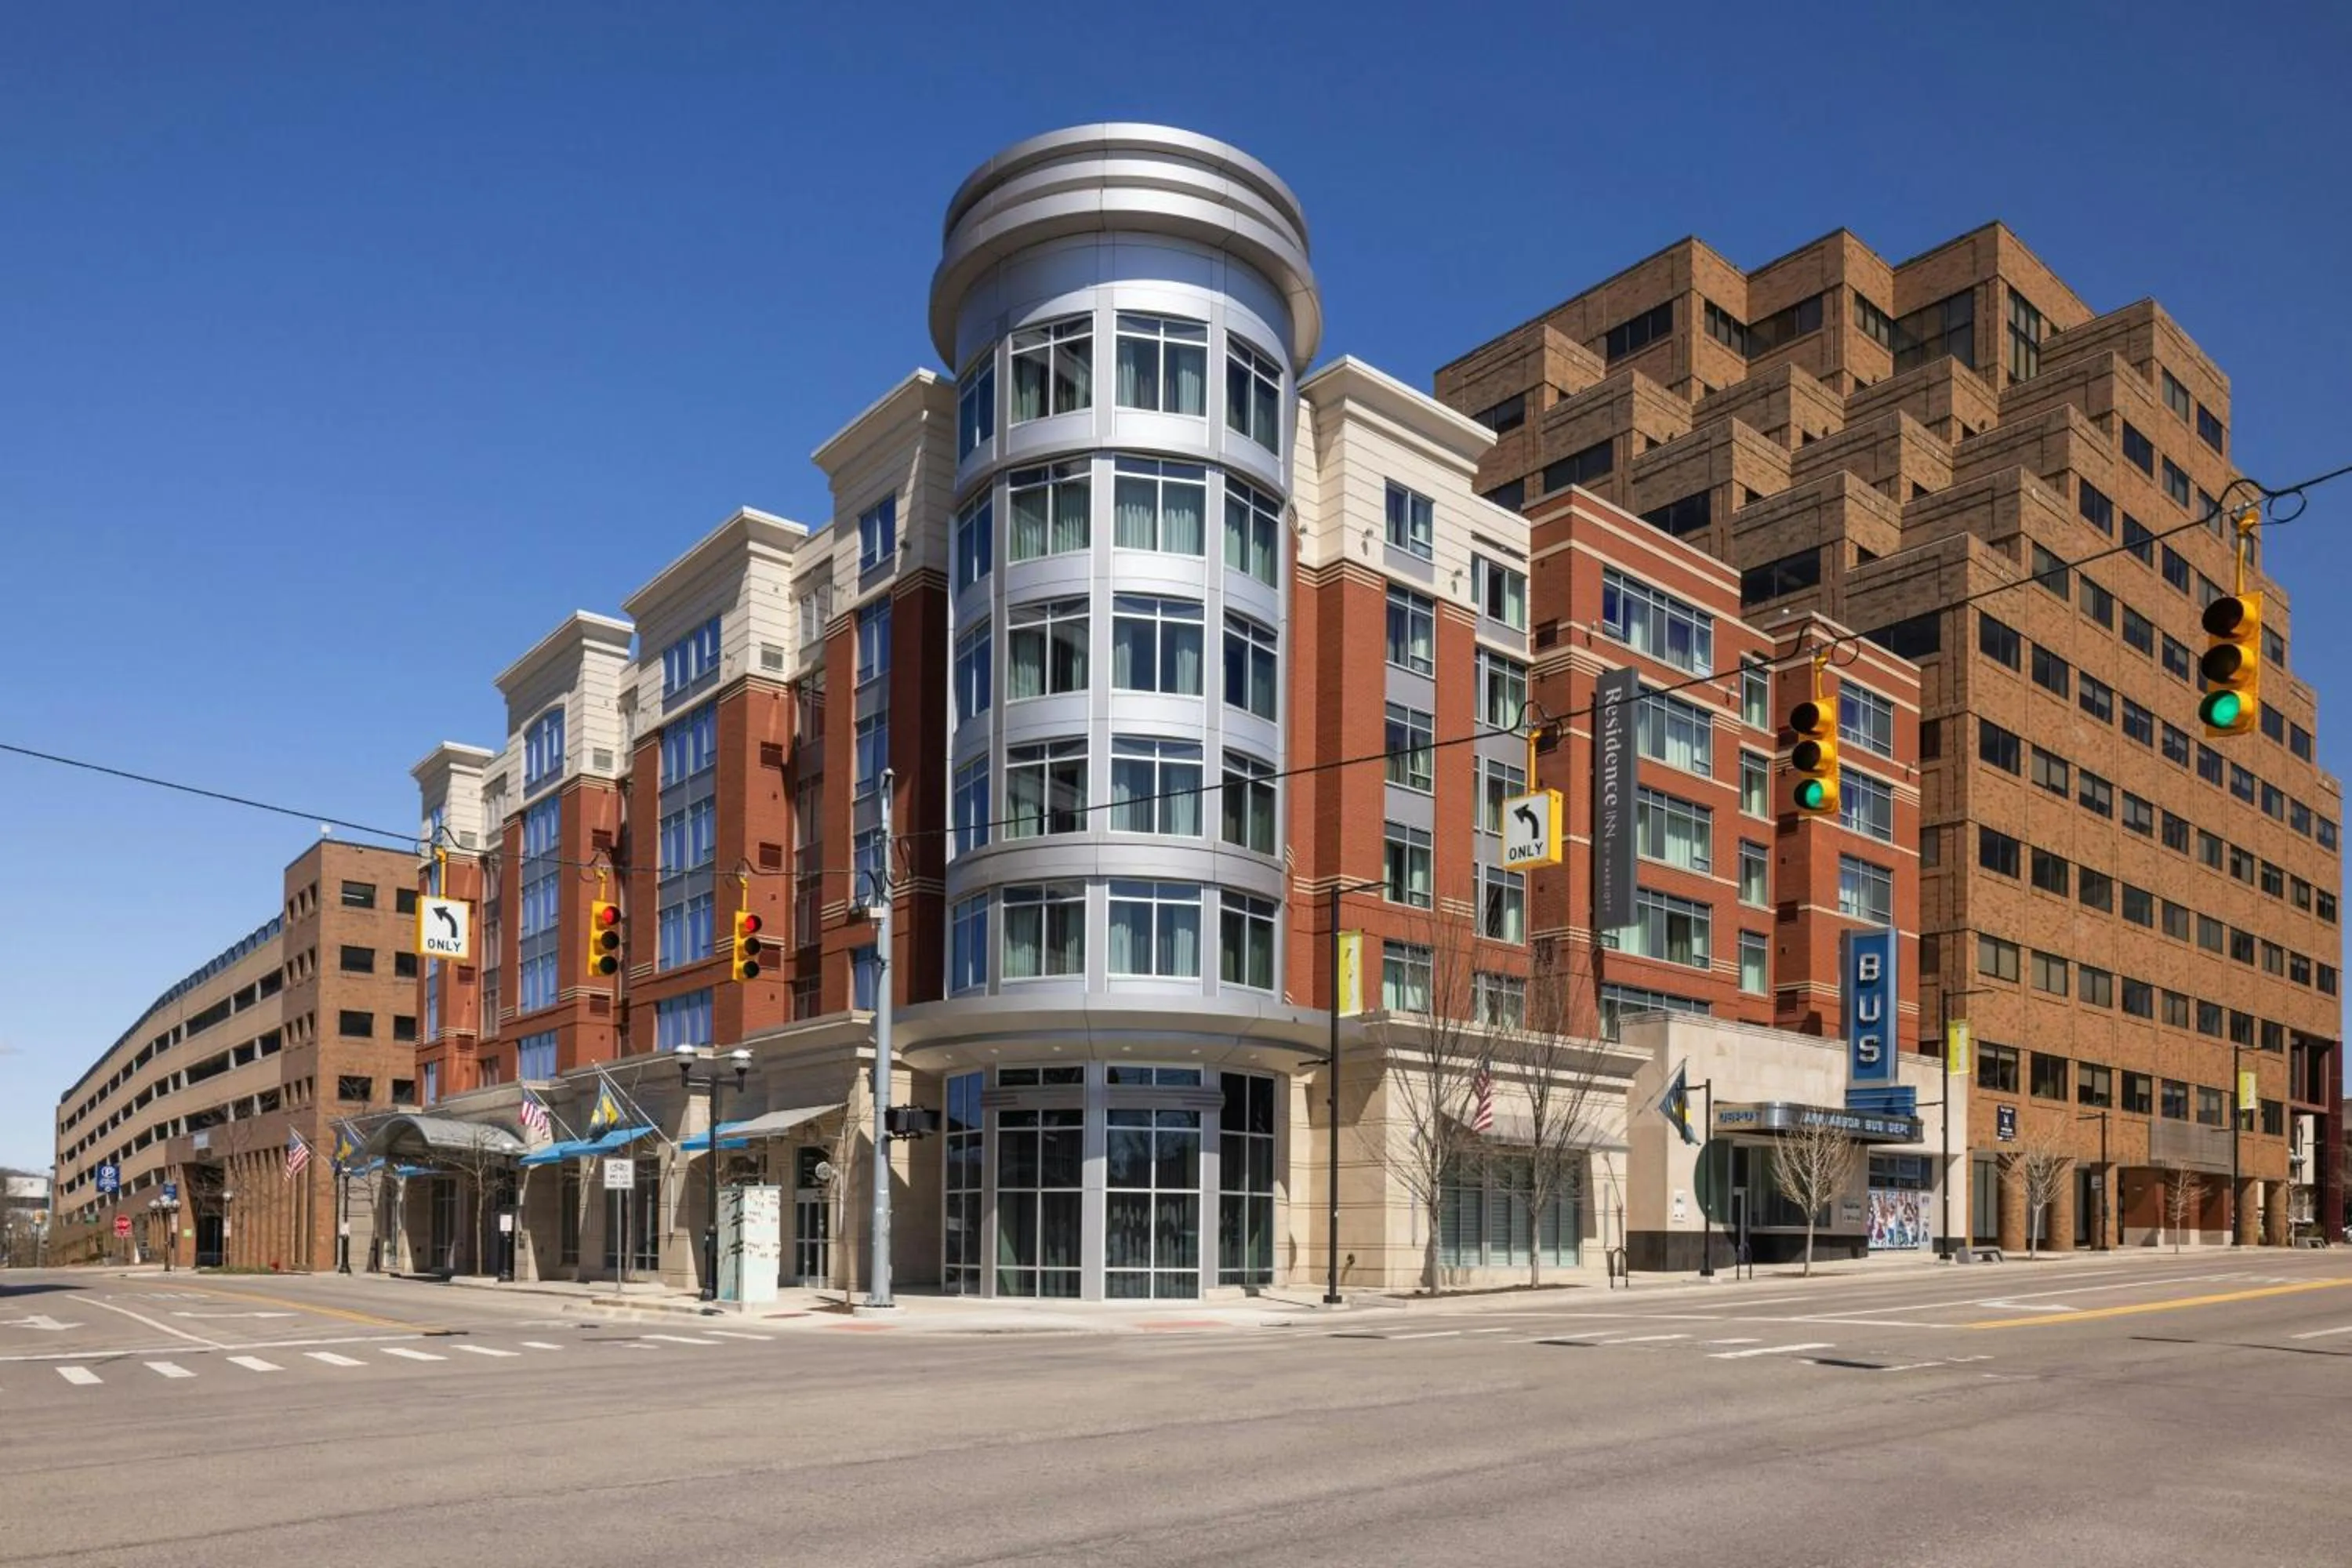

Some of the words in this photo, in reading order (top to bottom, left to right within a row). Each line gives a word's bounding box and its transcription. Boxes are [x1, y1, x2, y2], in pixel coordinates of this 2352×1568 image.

[1605, 686, 1622, 805] Residence
[1605, 810, 1617, 838] INN
[1509, 842, 1544, 860] ONLY
[427, 938, 462, 953] ONLY
[1859, 953, 1881, 1062] BUS
[1828, 1113, 1860, 1128] ARBOR
[1865, 1119, 1883, 1132] BUS
